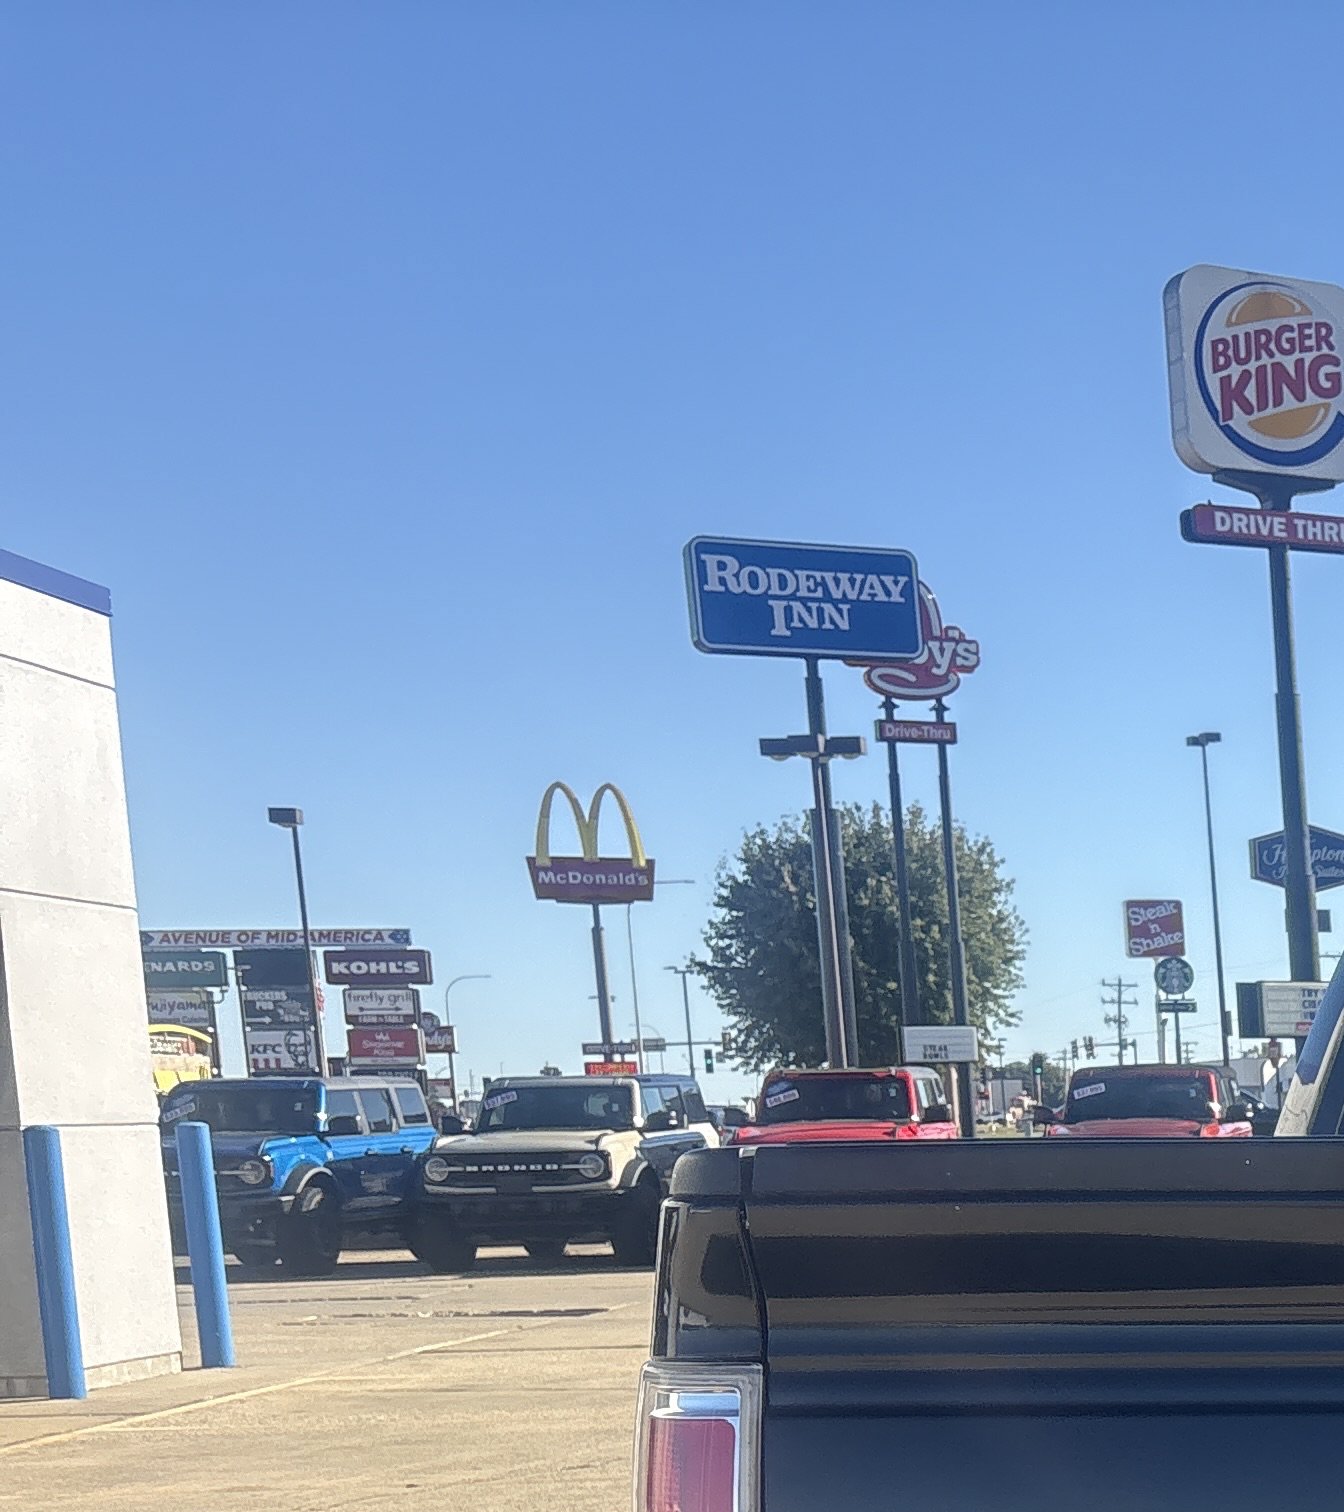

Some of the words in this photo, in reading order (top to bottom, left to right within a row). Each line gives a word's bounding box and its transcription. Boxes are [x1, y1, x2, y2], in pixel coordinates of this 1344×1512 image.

[1211, 321, 1336, 374] BURGER
[1219, 354, 1342, 423] KING
[1215, 511, 1287, 539] DRIVE
[700, 554, 909, 603] RODEWAY
[768, 600, 851, 637] INN
[884, 722, 951, 740] Drive-Thru
[538, 869, 648, 886] McDonald's
[1129, 901, 1177, 926] Steak
[158, 932, 231, 945] AVENUE
[236, 931, 261, 944] OF
[266, 930, 385, 943] MID-AMERICA
[1130, 931, 1184, 956] Shake
[331, 961, 420, 974] KOHL'S
[250, 1044, 282, 1055] KFC
[466, 1163, 559, 1172] BRONCO
